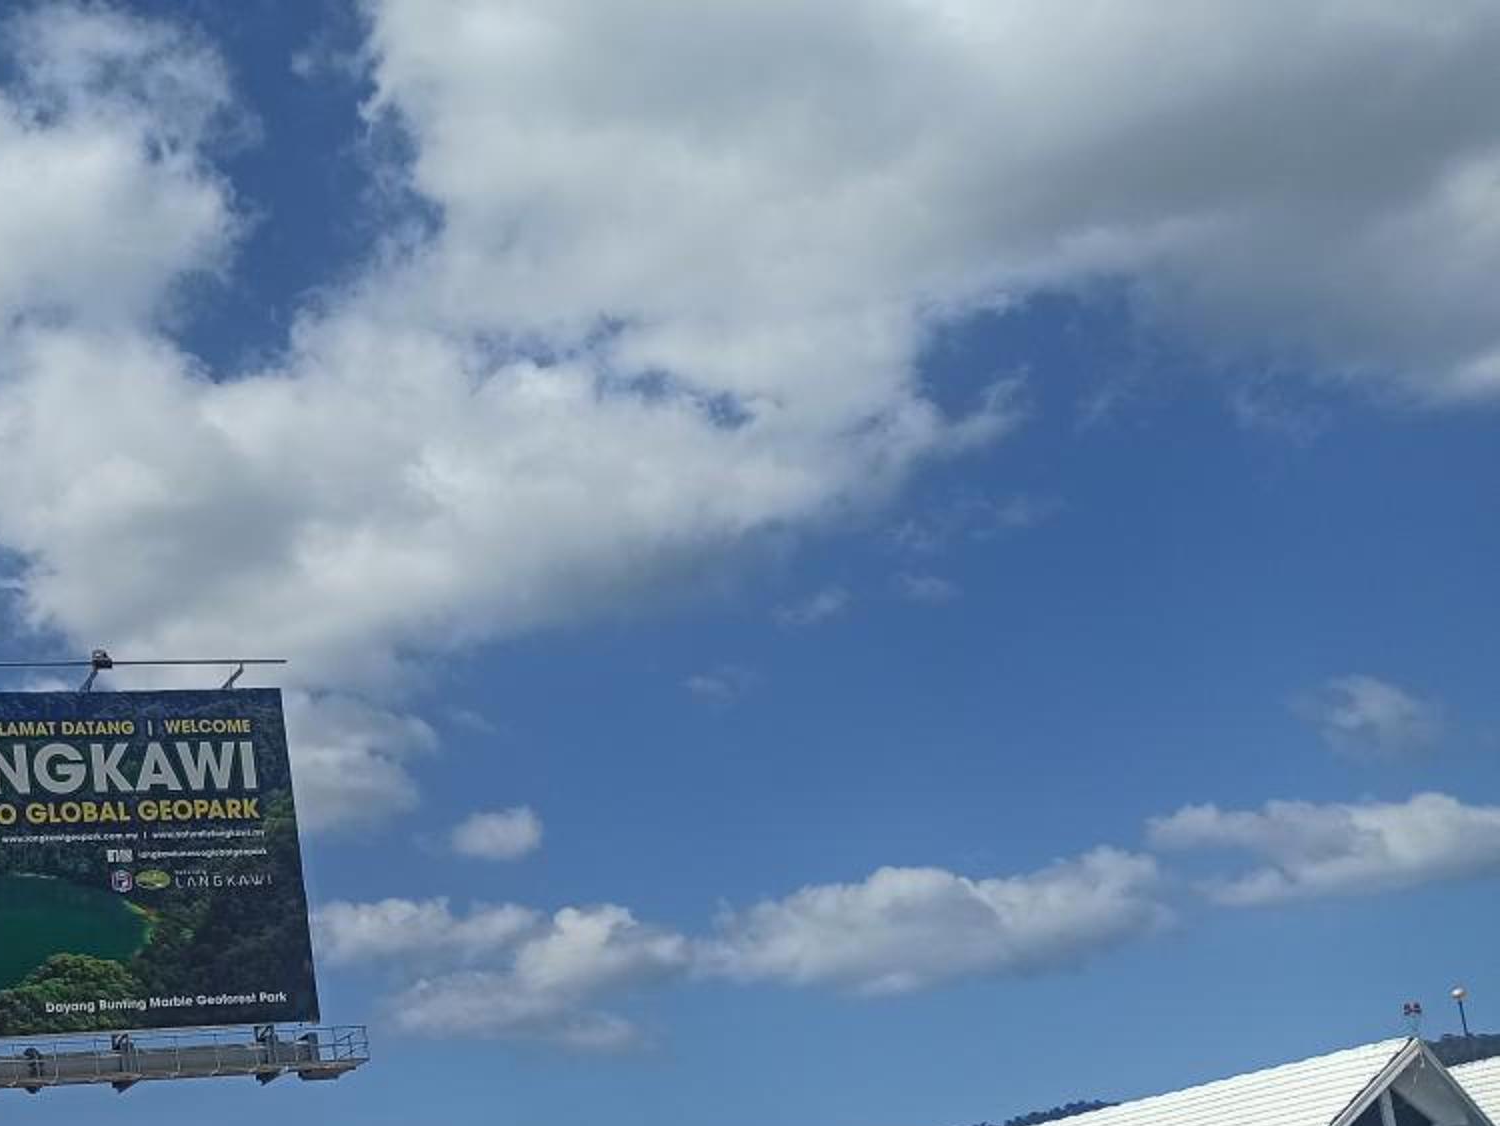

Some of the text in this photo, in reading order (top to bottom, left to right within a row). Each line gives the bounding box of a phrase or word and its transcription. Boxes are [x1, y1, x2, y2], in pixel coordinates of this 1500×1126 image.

[61, 720, 135, 736] DATANG
[164, 719, 251, 734] WELCOME
[25, 801, 131, 824] GLOBAL
[137, 797, 261, 821] GEOPARK
[45, 1000, 95, 1014] Dayang
[149, 996, 193, 1008] Marble
[196, 993, 256, 1006] Geoforest
[259, 991, 287, 1003] Park
